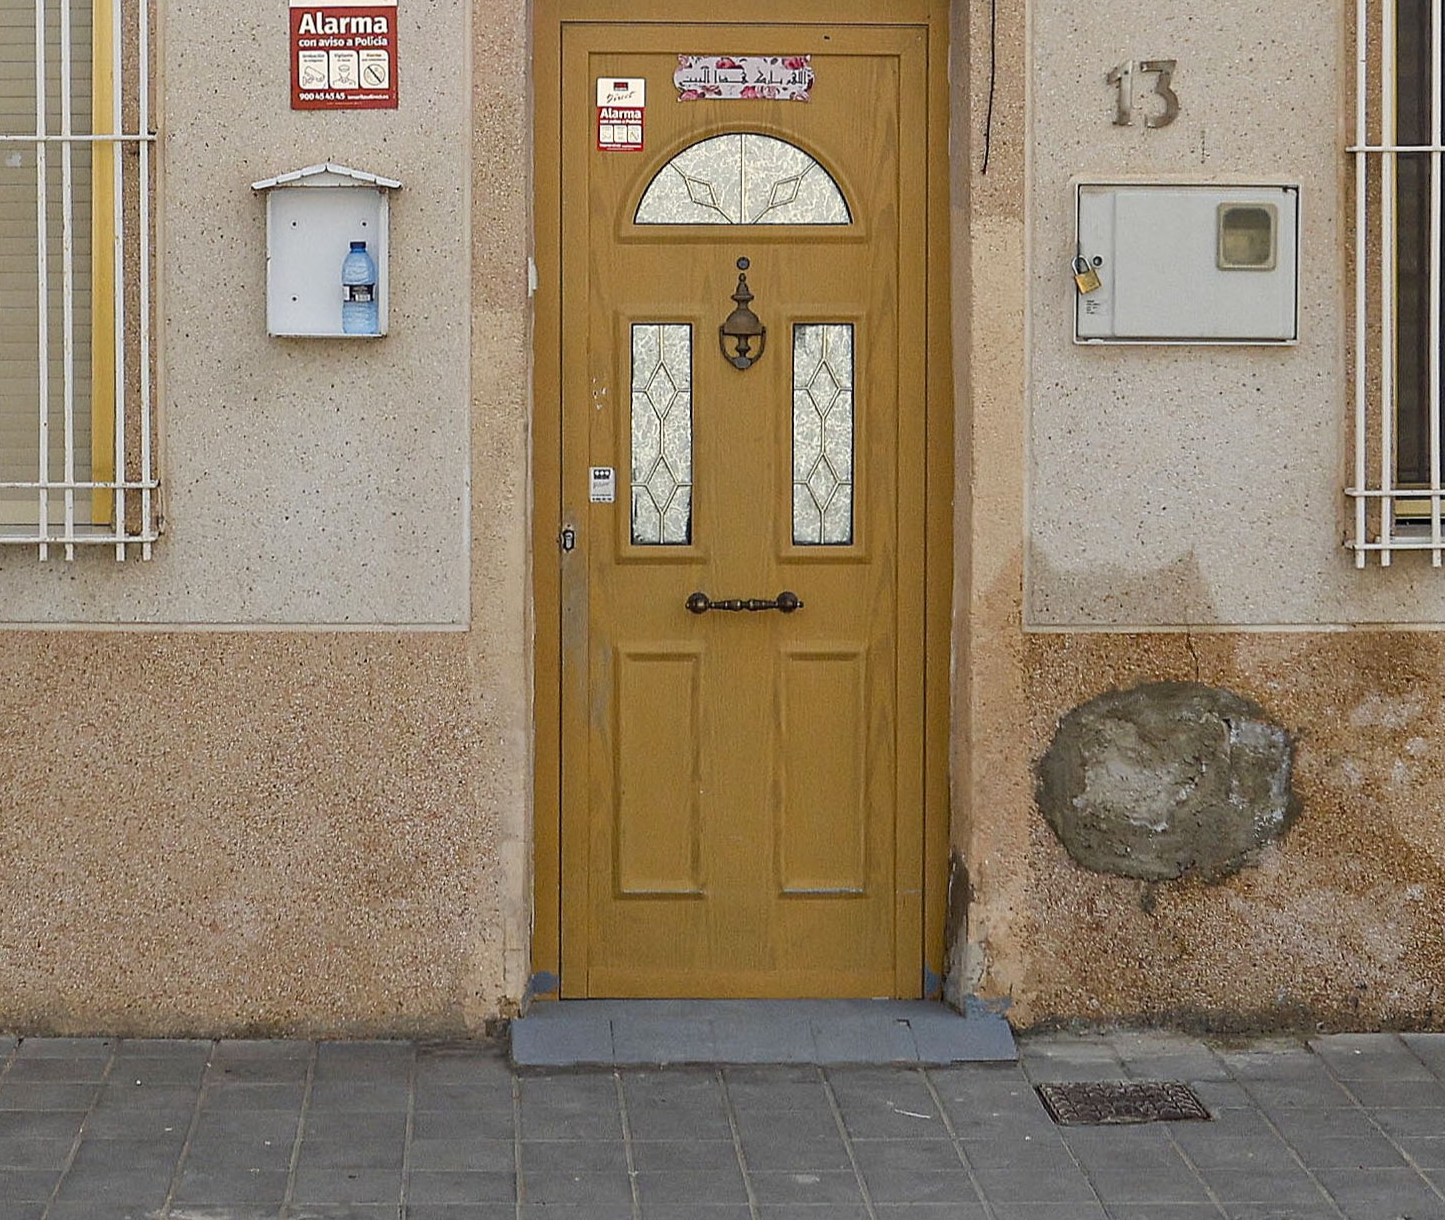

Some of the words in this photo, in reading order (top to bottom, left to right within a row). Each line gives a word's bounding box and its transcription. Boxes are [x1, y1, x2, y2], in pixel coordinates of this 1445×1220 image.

[298, 11, 388, 34] Alarma
[298, 38, 317, 47] con
[318, 36, 344, 47] aviso
[346, 38, 353, 47] a
[354, 36, 388, 47] Policía
[1107, 59, 1180, 129] 13
[600, 108, 641, 119] Alarma
